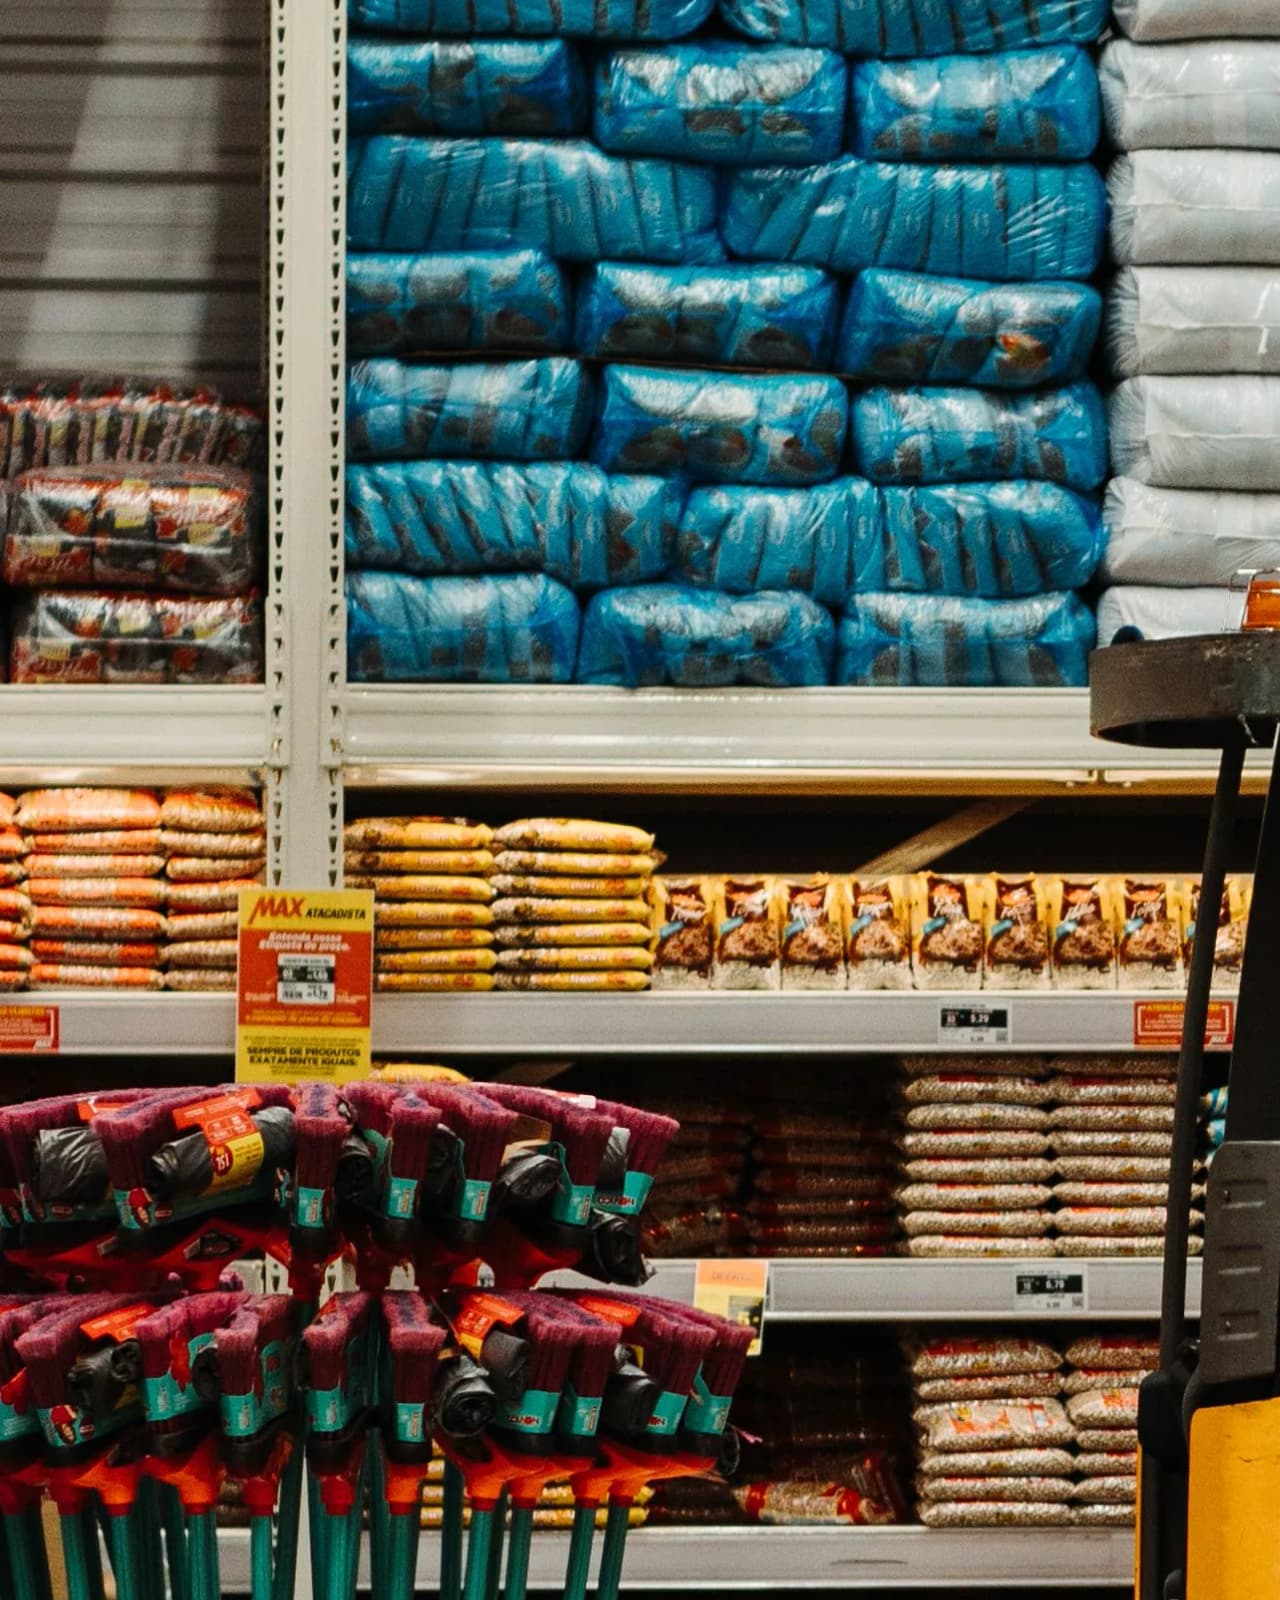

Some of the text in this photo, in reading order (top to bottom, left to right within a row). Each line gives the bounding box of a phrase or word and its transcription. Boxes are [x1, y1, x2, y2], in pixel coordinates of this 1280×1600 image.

[248, 897, 366, 926] MAX ATACADISTA
[305, 1047, 361, 1057] PRODUTOS
[250, 1057, 318, 1066] EXATAMENTE
